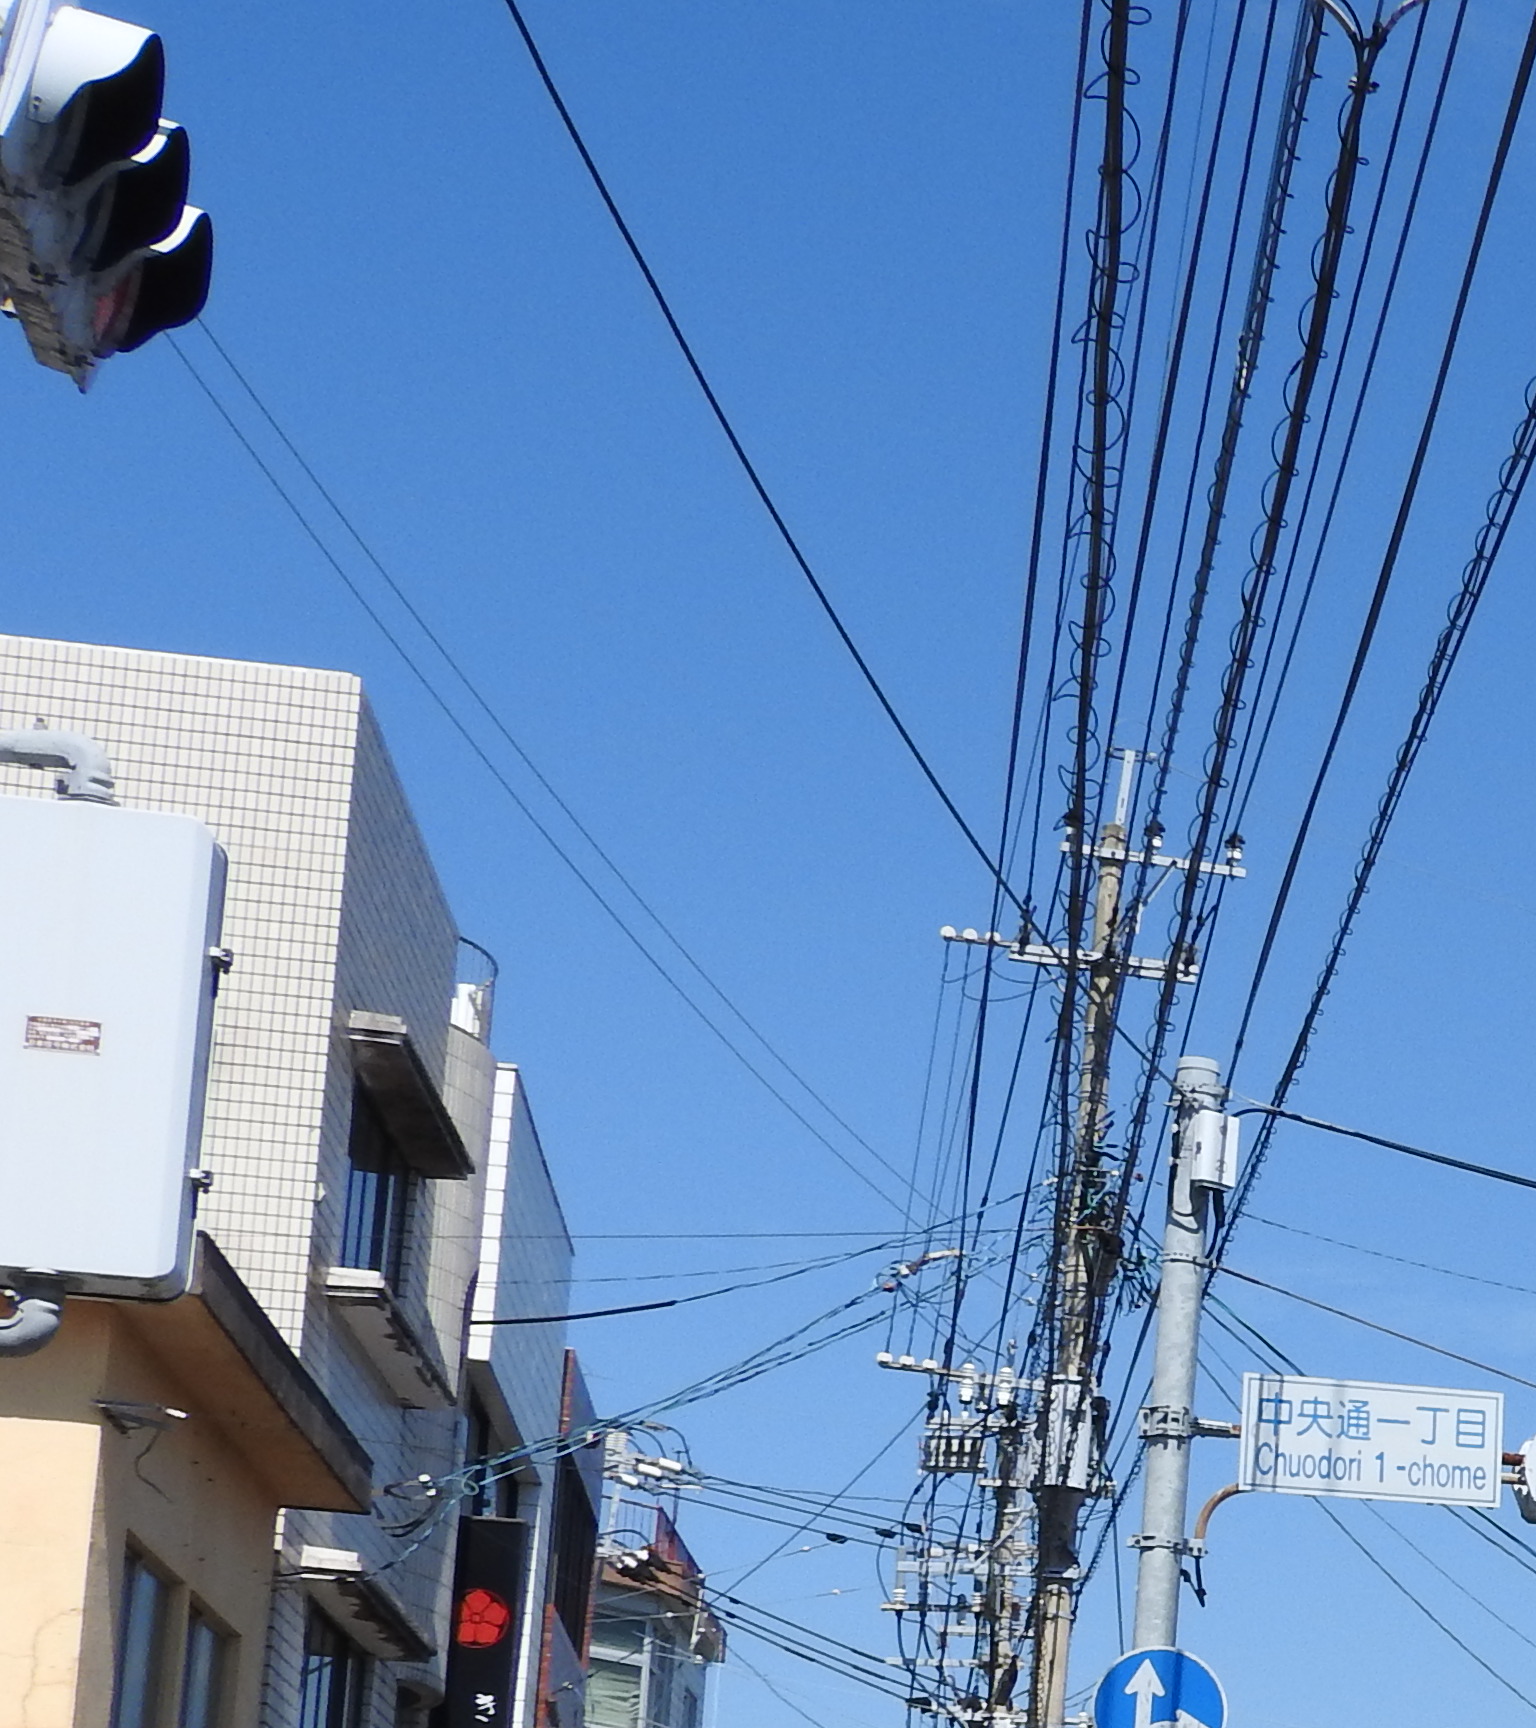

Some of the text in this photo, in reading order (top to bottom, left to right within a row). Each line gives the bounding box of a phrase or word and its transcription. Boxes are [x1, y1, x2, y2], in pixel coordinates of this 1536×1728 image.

[1258, 1391, 1487, 1449] 中央通一丁目
[1255, 1442, 1362, 1482] Chuodori
